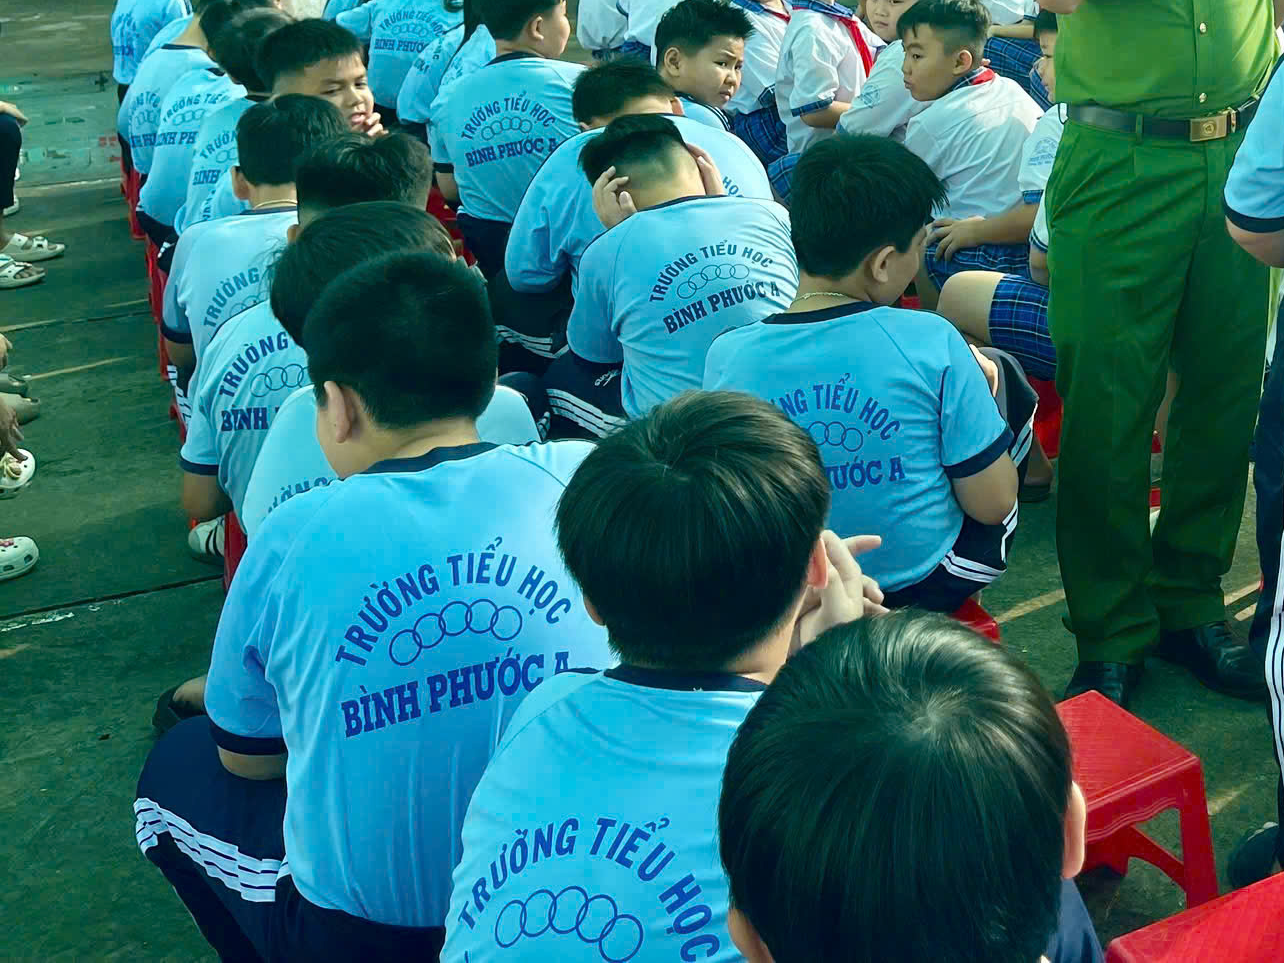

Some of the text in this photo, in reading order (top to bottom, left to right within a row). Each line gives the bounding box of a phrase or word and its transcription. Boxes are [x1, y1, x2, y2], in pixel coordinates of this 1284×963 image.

[461, 100, 501, 140] TRƯỜNG
[504, 90, 531, 113] TIỂU
[722, 176, 745, 197] HỌ
[203, 267, 260, 328] TRƯỜNG
[649, 239, 774, 302] TRƯỜNG TIỂU HỌC
[663, 279, 781, 334] BÌNH PHƯỚC A
[219, 331, 289, 397] TRƯỜNG
[220, 404, 269, 432] BÌNH
[813, 372, 859, 413] TIỂU
[858, 397, 900, 441] HỌC
[825, 455, 906, 490] ƯỚC A
[335, 536, 571, 666] TRƯỜNG TIỂU HỌC
[341, 680, 421, 738] BÌNH
[426, 646, 544, 713] PHƯỚC
[457, 816, 721, 963] TRƯỜNG TIỂU HỌC
